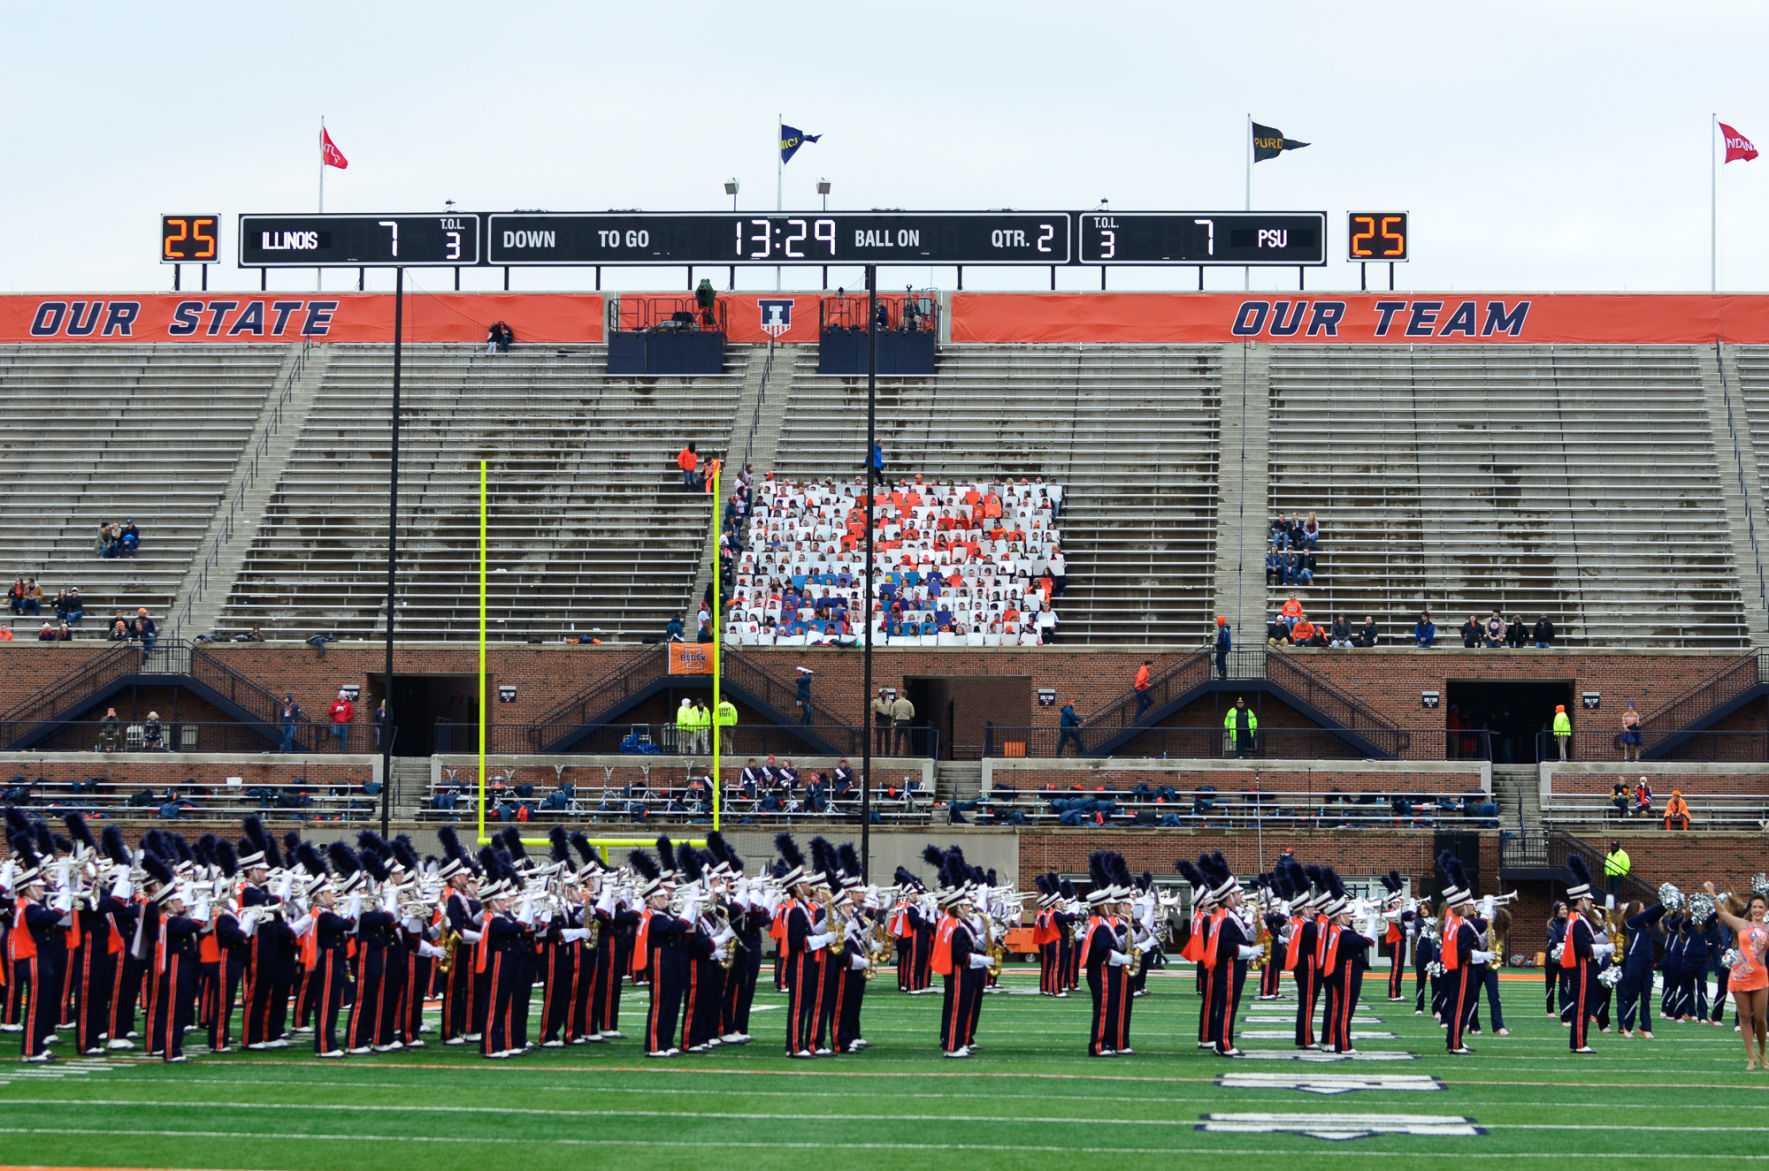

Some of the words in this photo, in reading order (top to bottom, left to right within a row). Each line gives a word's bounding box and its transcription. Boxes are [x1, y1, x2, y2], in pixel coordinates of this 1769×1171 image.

[440, 218, 466, 230] T.O.L.
[1094, 216, 1120, 229] T.O.L.
[1352, 216, 1404, 256] 25
[164, 218, 215, 258] 25
[262, 231, 318, 250] ILLINOIS
[378, 221, 398, 257] 7
[446, 231, 460, 260] 3
[503, 230, 556, 248] DOWN
[598, 230, 620, 248] TO
[625, 230, 649, 248] GO
[736, 219, 836, 258] 13:29
[854, 229, 894, 248] BALL
[897, 229, 920, 247] ON
[991, 230, 1030, 248] QTR.
[1037, 224, 1054, 252] 2
[1100, 230, 1115, 258] 3
[1194, 219, 1214, 256] 7
[1257, 229, 1288, 248] PSU
[29, 300, 140, 337] OUR
[168, 300, 340, 337] STATE
[1231, 300, 1346, 337] OUR
[1374, 300, 1531, 337] TEAM
